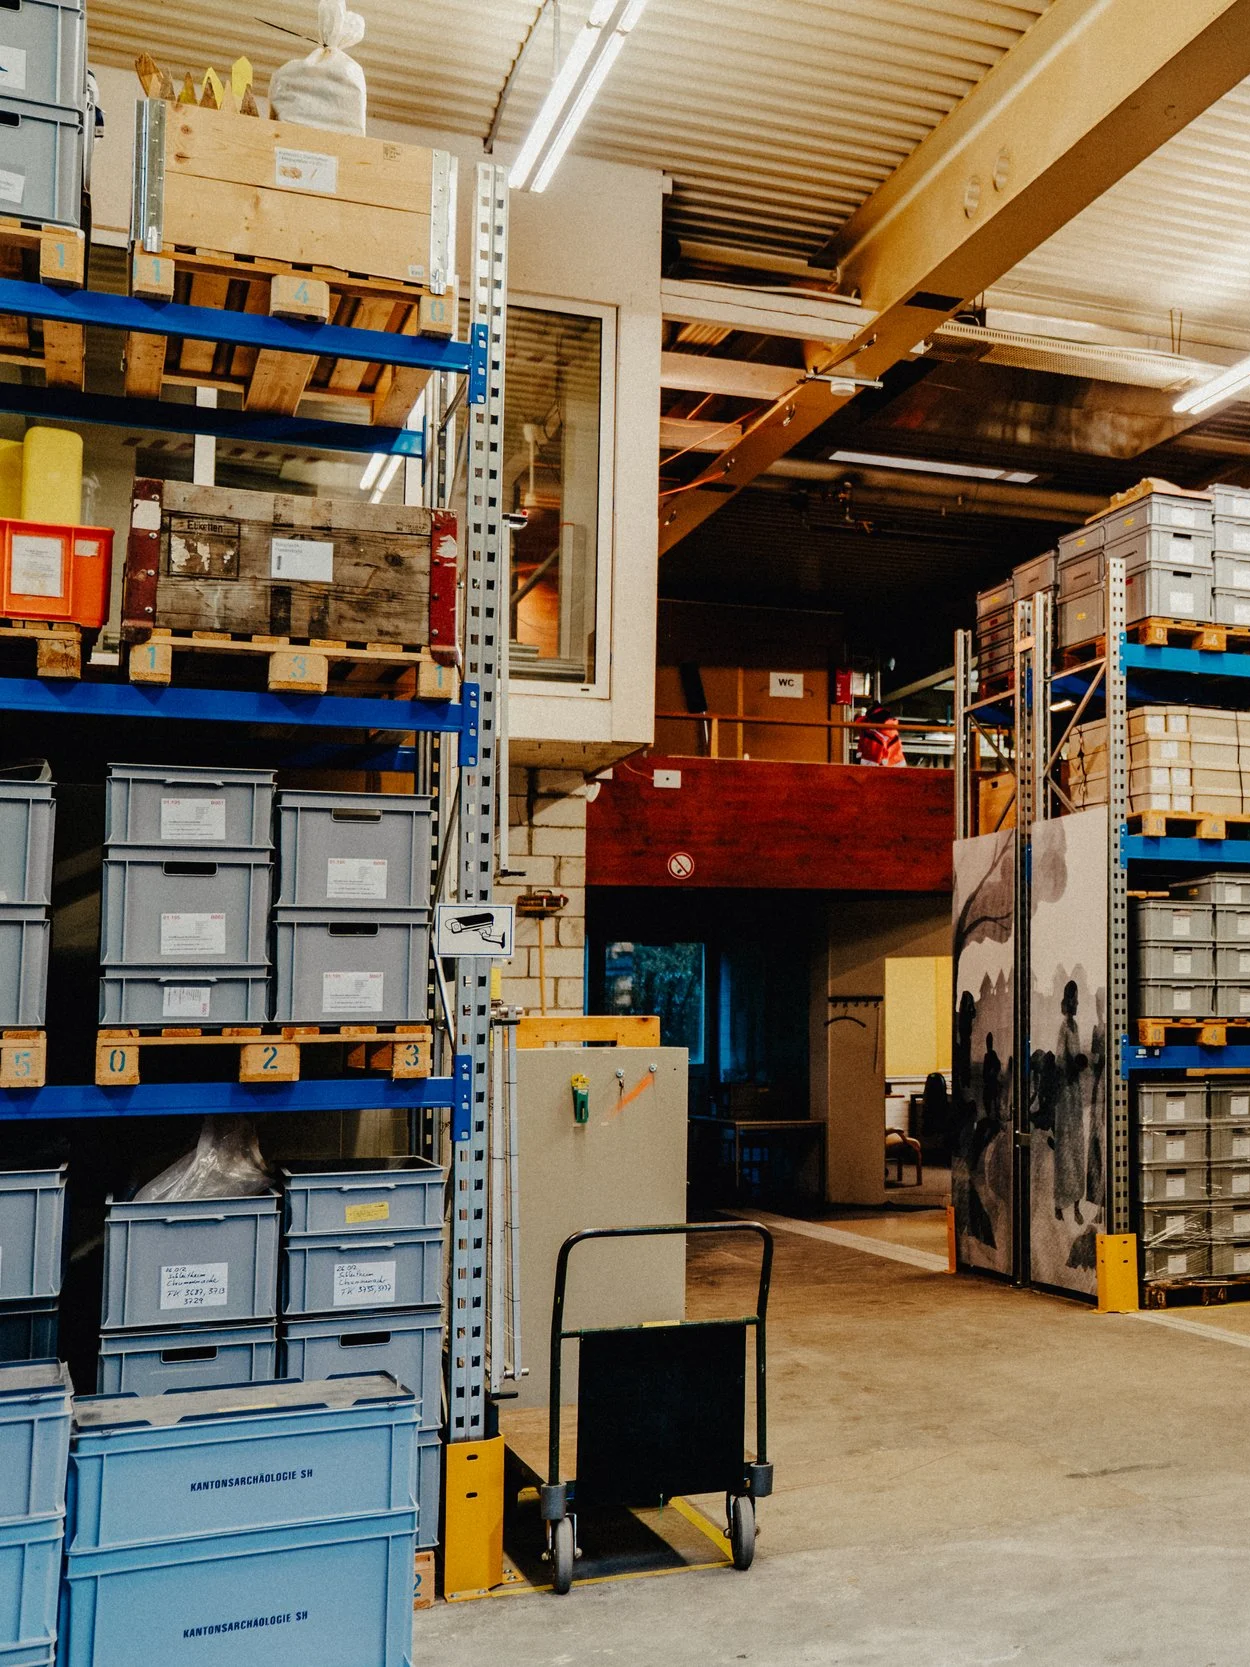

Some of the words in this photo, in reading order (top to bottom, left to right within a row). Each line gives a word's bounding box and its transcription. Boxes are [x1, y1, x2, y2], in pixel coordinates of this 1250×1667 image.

[55, 243, 64, 269] 1
[151, 258, 161, 283] 1
[293, 280, 308, 304] 4
[431, 299, 444, 322] 0
[187, 520, 223, 533] Etiketten
[147, 645, 156, 669] 1
[290, 655, 306, 678] 3
[434, 664, 443, 688] 1
[778, 678, 795, 687] WC
[14, 1052, 31, 1078] 5
[109, 1048, 125, 1073] 0
[263, 1046, 278, 1070] 2
[405, 1044, 419, 1068] 3
[190, 1471, 297, 1492] KANTONSARCHÄOLOGIE
[300, 1469, 313, 1479] SH
[183, 1613, 291, 1639] KANTONSARCHÄOLOGIE
[295, 1610, 308, 1621] SH
